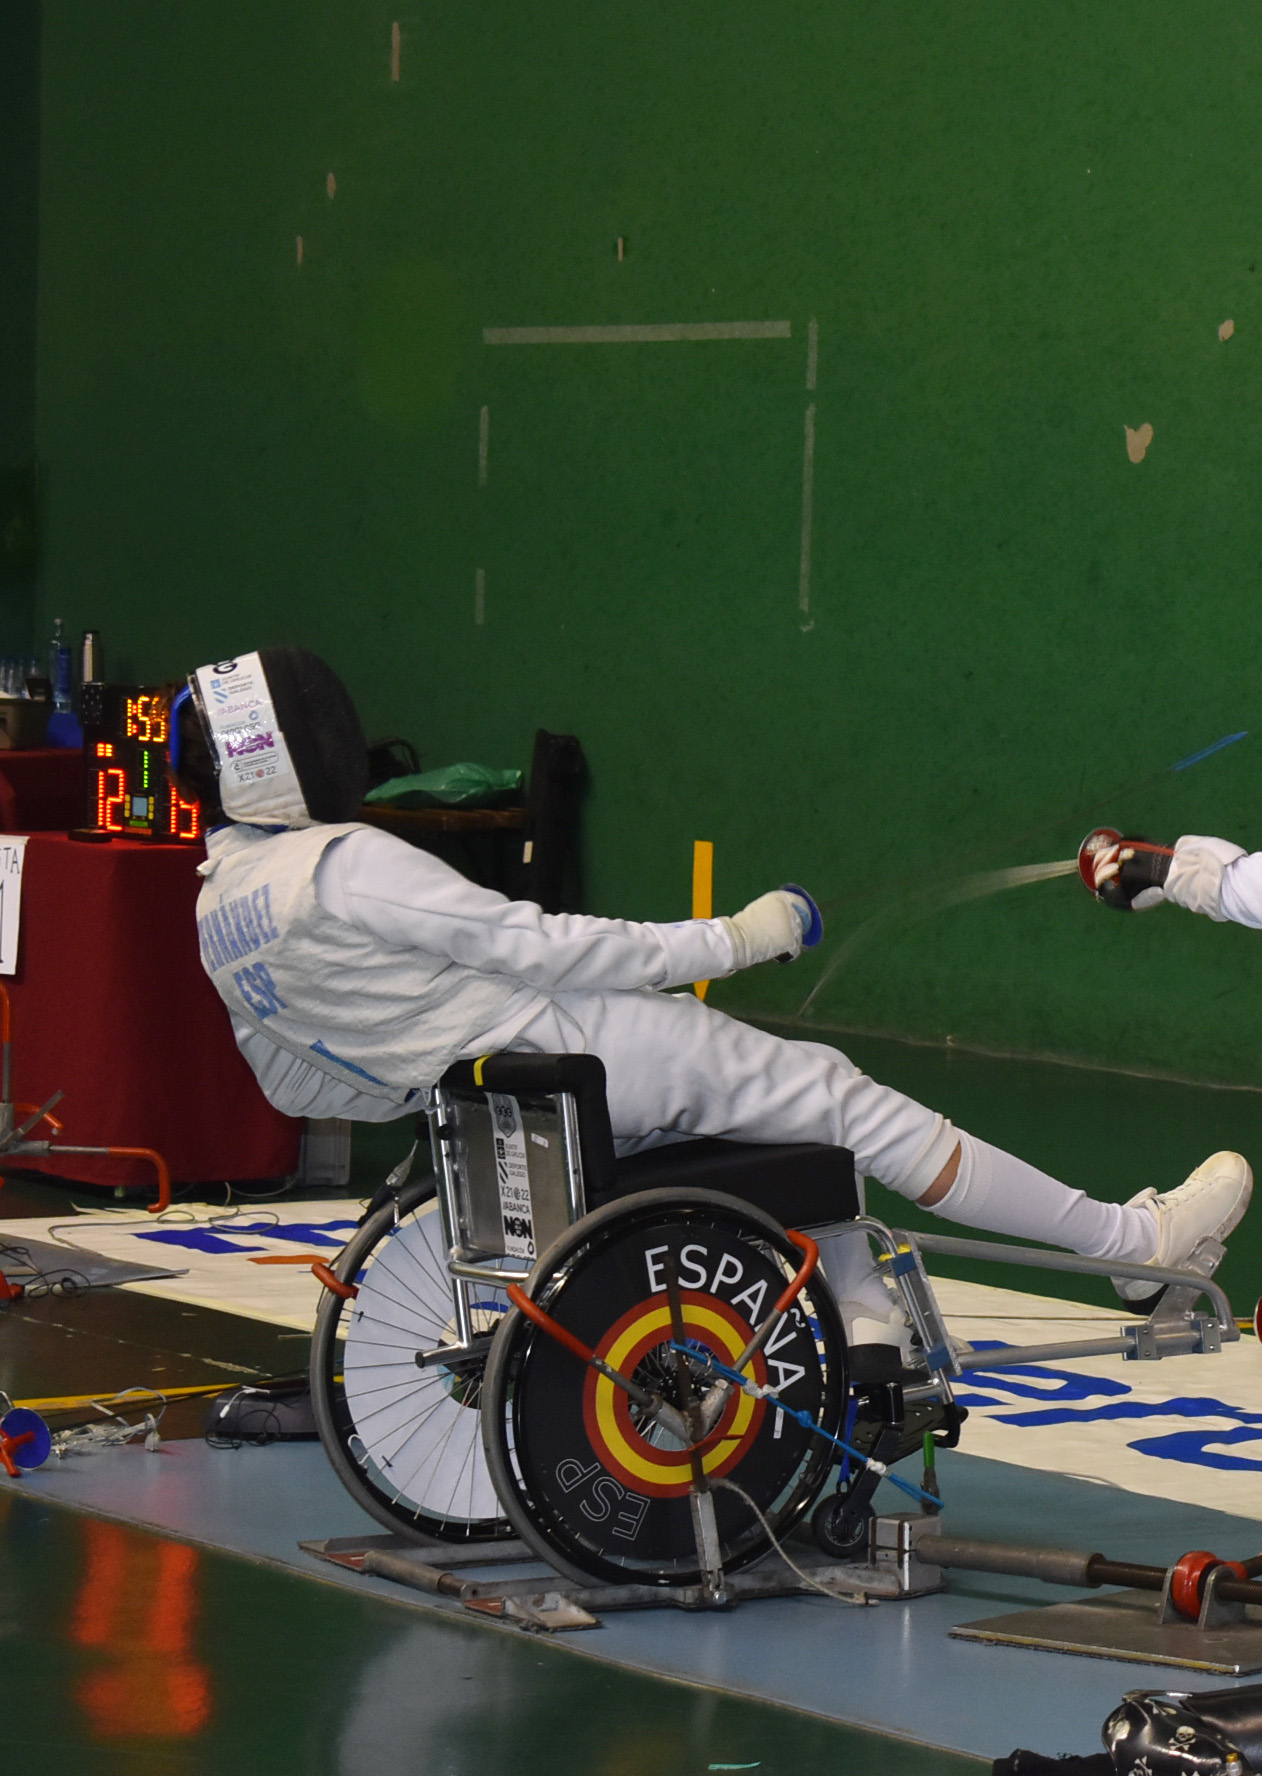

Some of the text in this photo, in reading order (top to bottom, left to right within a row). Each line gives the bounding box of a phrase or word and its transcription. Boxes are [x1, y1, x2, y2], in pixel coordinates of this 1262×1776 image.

[266, 765, 277, 776] 22
[232, 961, 288, 1021] ESP
[520, 1188, 530, 1201] 22
[644, 1244, 806, 1394] ESPAÑA
[555, 1457, 651, 1541] ESP
